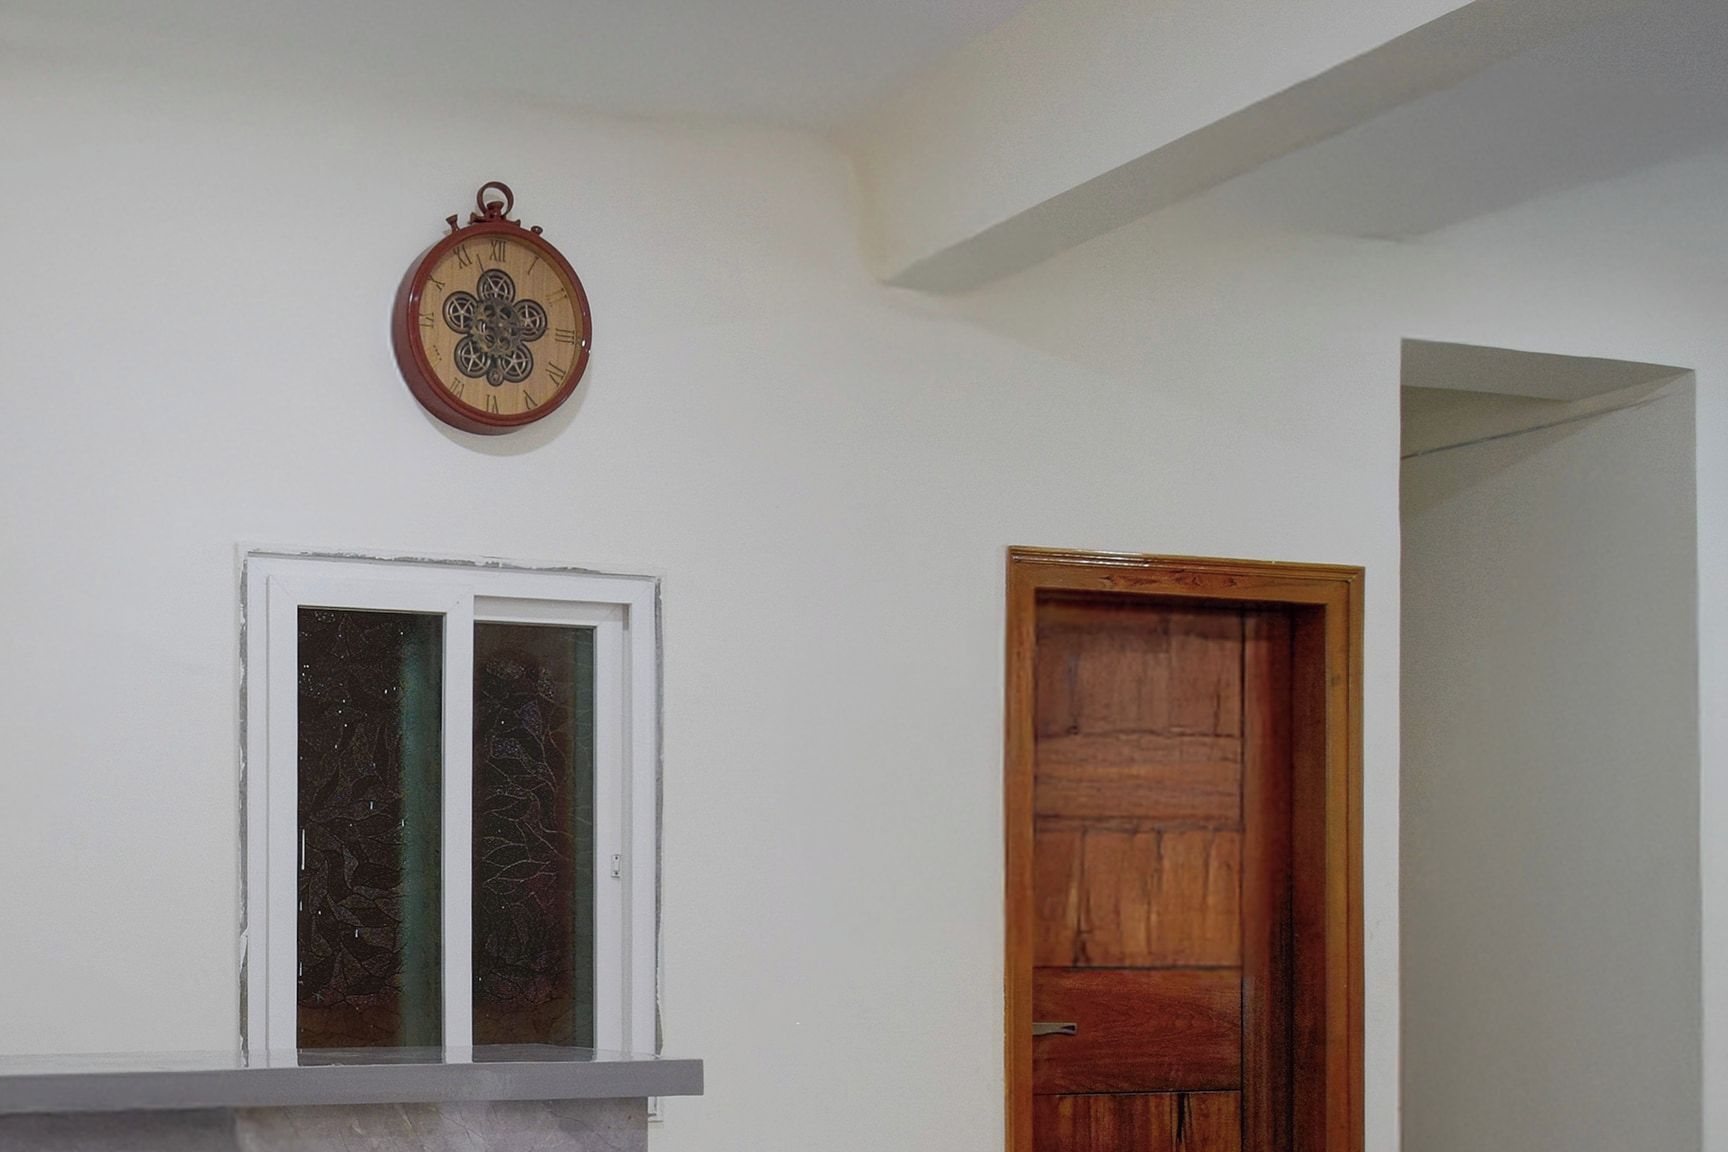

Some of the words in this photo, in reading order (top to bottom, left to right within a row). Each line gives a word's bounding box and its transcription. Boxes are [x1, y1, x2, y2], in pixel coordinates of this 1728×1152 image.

[453, 244, 473, 270] XI
[489, 241, 506, 263] XII
[555, 327, 575, 345] III
[545, 361, 567, 387] IV
[523, 389, 538, 410] V
